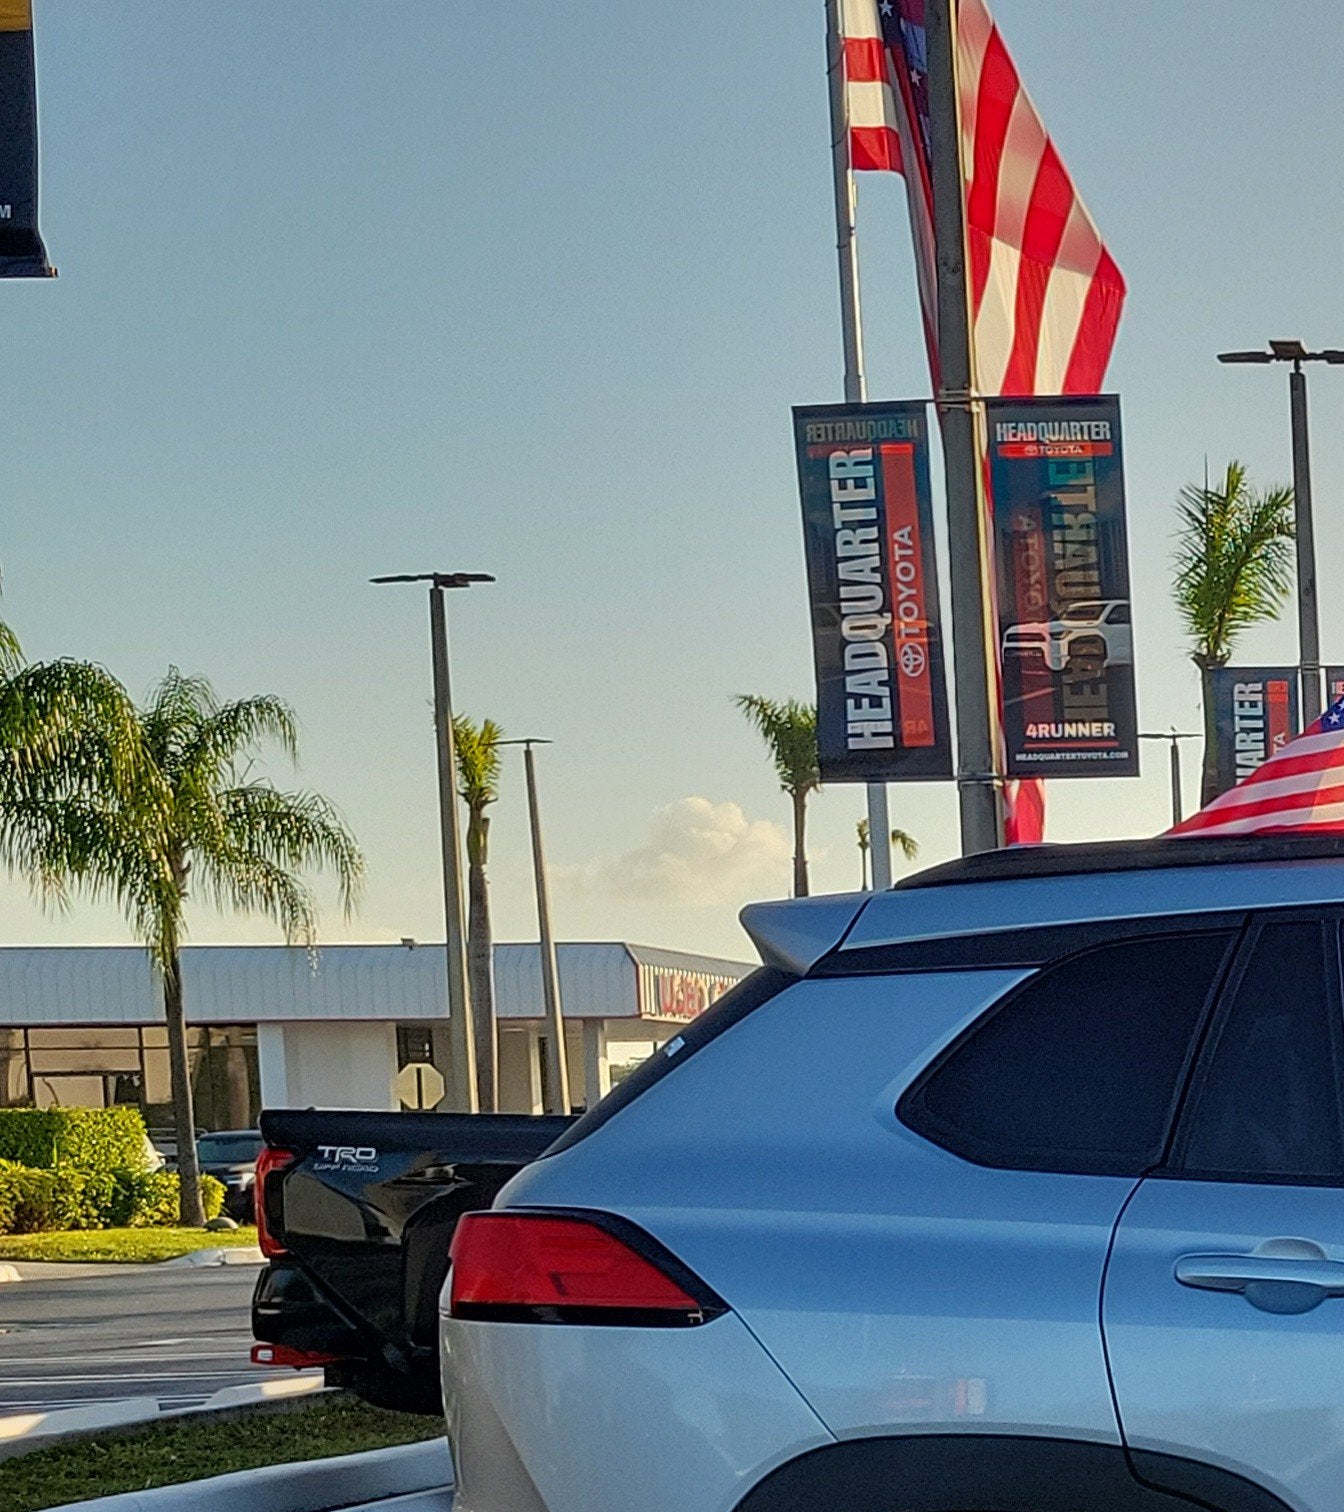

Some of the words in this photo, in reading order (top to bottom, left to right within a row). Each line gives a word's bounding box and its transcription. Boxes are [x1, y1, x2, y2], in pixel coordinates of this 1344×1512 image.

[996, 421, 1111, 443] HEADQUARTER
[1040, 444, 1083, 455] TOYOTA
[893, 524, 921, 639] TOYOTA
[828, 446, 895, 751] HEADQUARTER
[1026, 722, 1116, 738] 4RUNNER
[1234, 682, 1265, 785] ARTER
[317, 1145, 376, 1163] TRD
